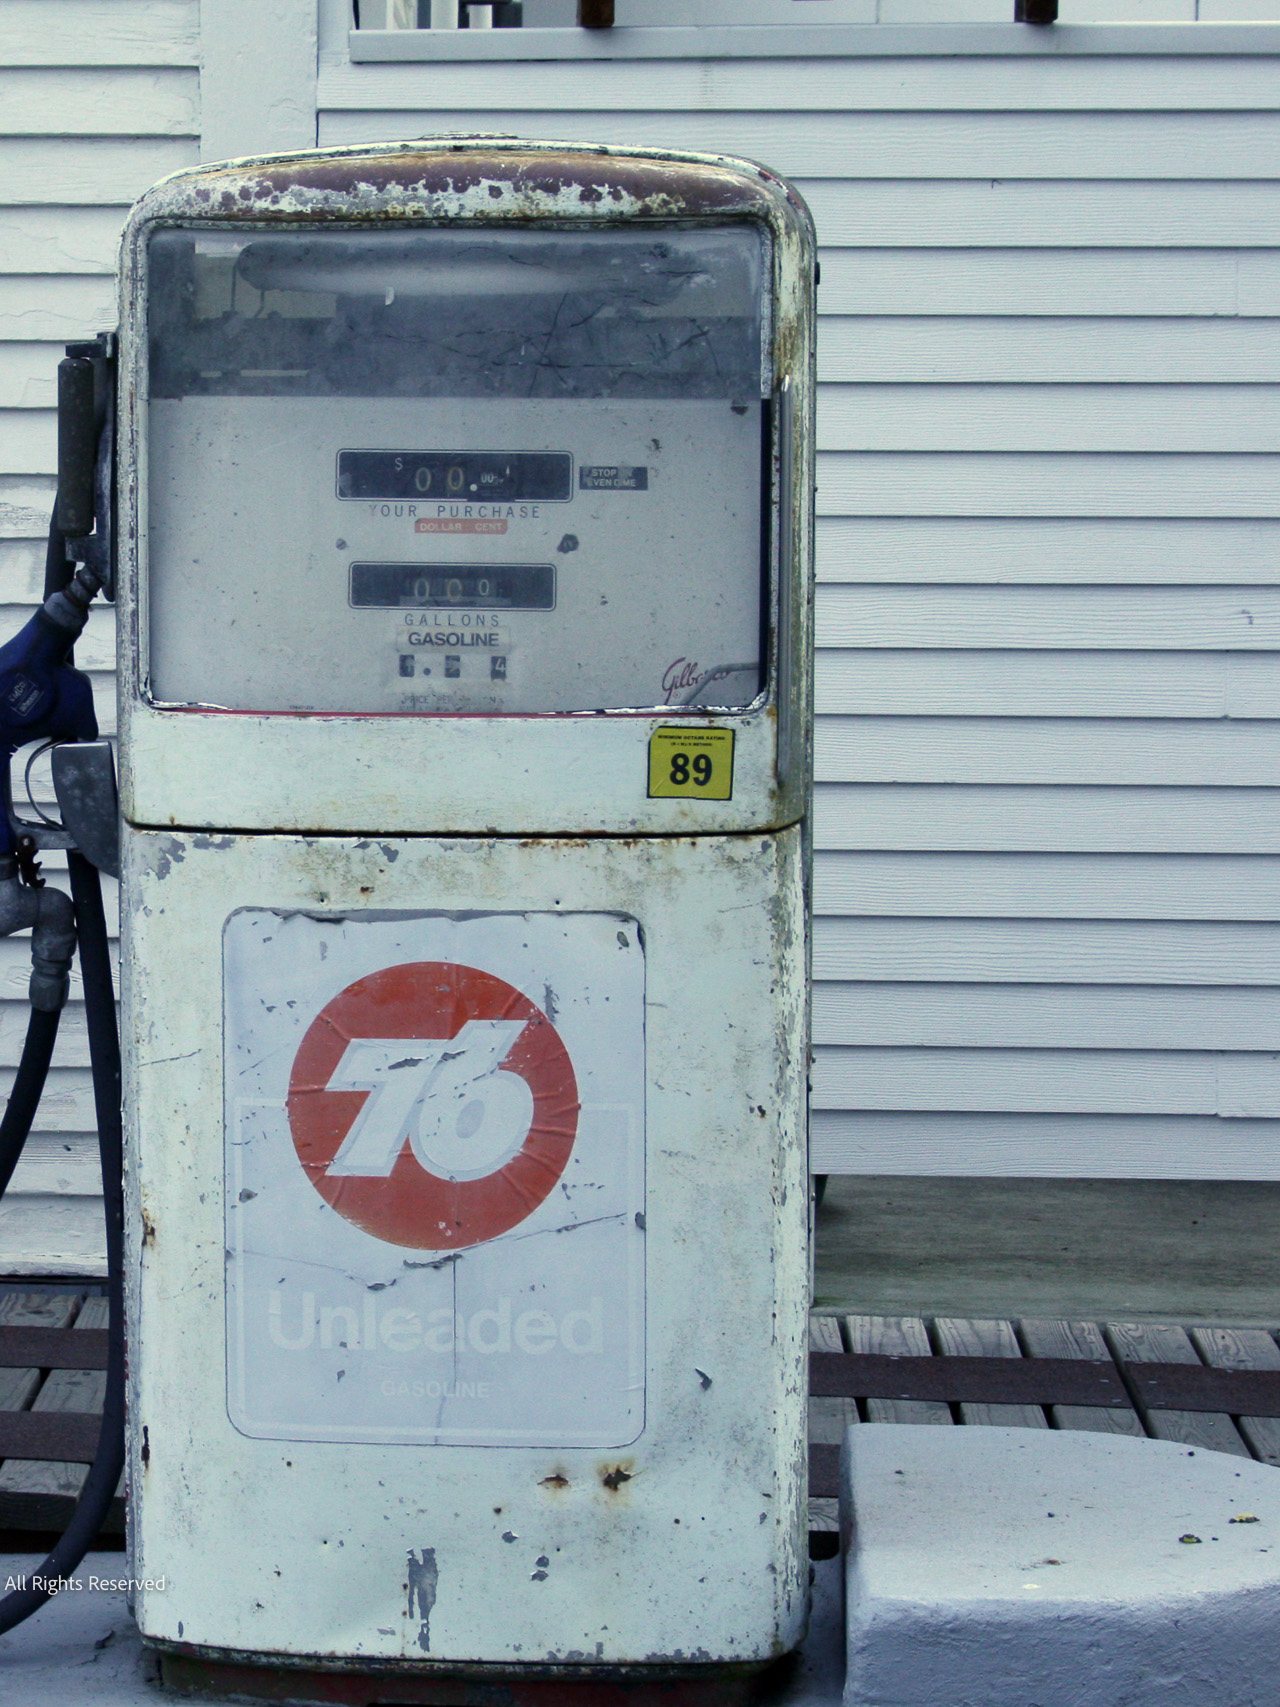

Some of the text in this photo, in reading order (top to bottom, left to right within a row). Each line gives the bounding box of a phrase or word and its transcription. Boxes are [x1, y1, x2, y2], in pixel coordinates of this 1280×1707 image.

[394, 457, 403, 472] $
[591, 469, 617, 477] STOP
[369, 504, 540, 519] YOUR PURCHASE
[419, 522, 503, 531] DOLLAR CENT
[404, 614, 499, 627] GALLONS
[408, 632, 500, 647] GASOLINE
[670, 753, 713, 787] 89
[325, 1019, 534, 1182] 76
[268, 1290, 603, 1356] Unleaded
[380, 1379, 490, 1400] GASOLINE
